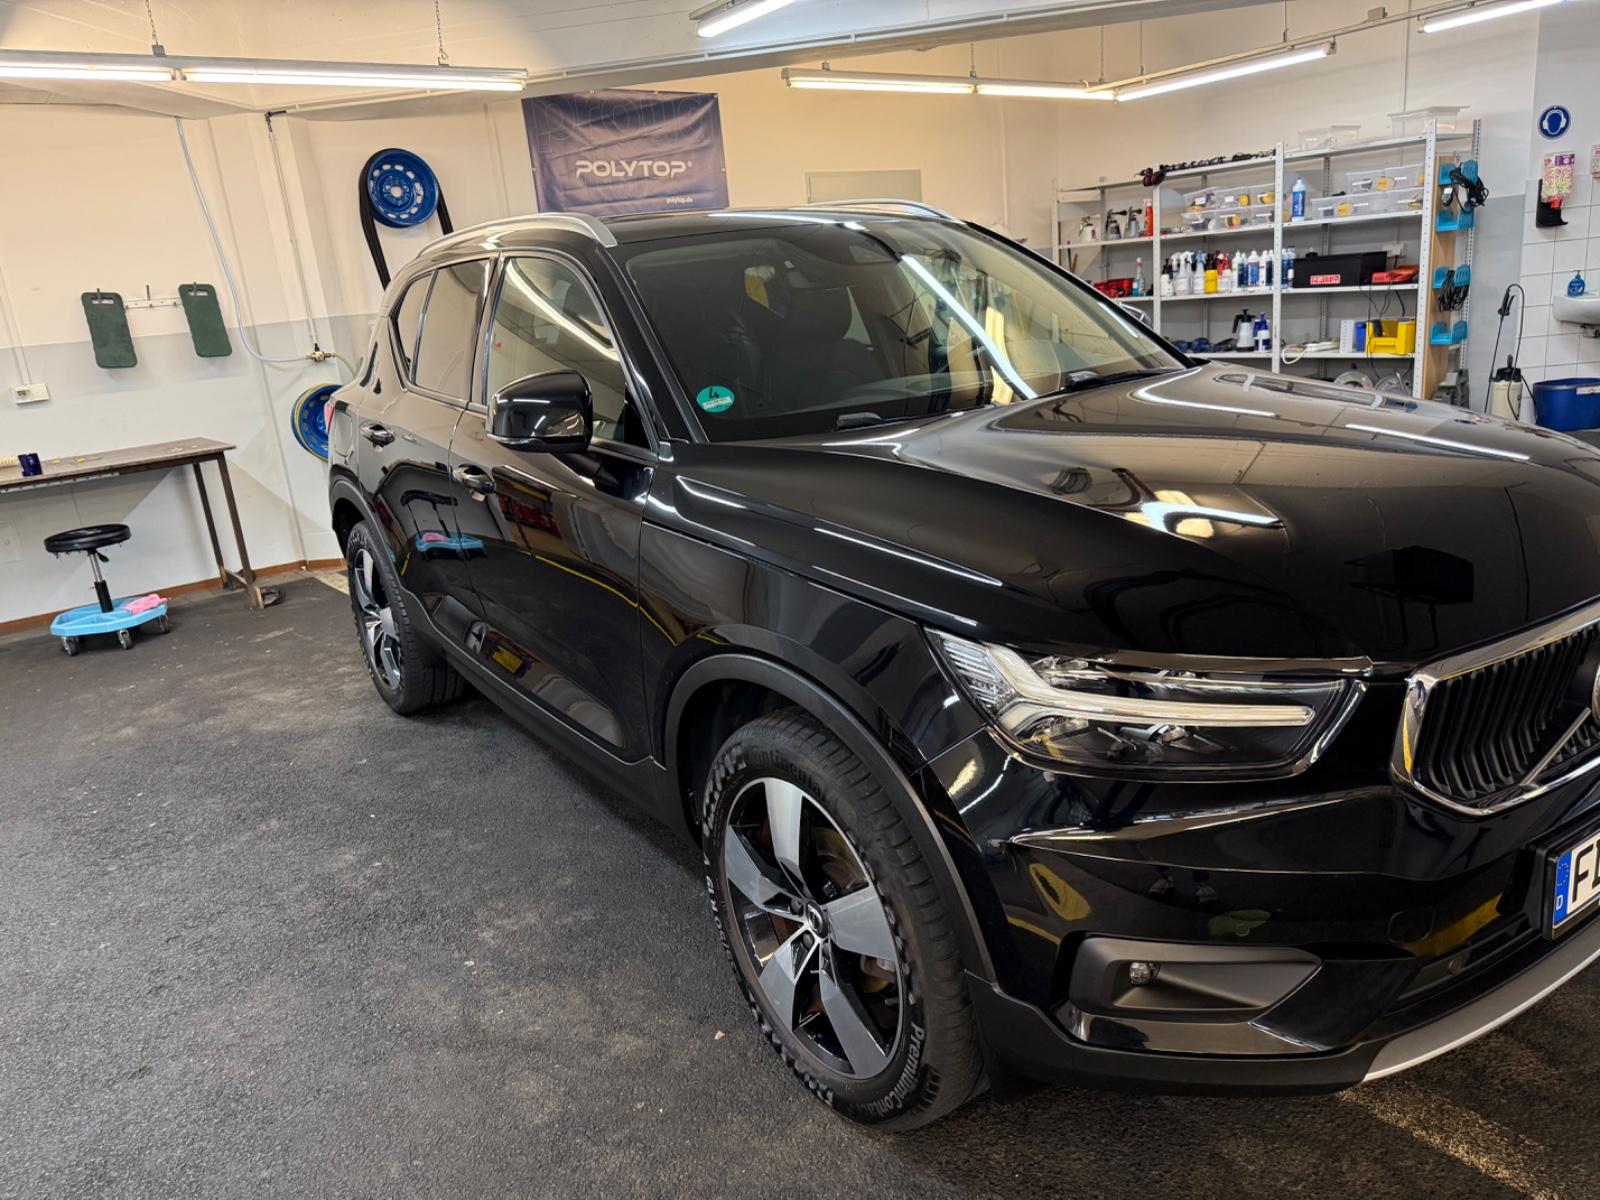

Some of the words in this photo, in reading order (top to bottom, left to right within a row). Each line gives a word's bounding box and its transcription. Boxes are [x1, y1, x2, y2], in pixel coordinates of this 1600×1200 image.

[576, 160, 688, 179] POLYTOP
[708, 387, 720, 398] 4
[1555, 894, 1563, 910] D
